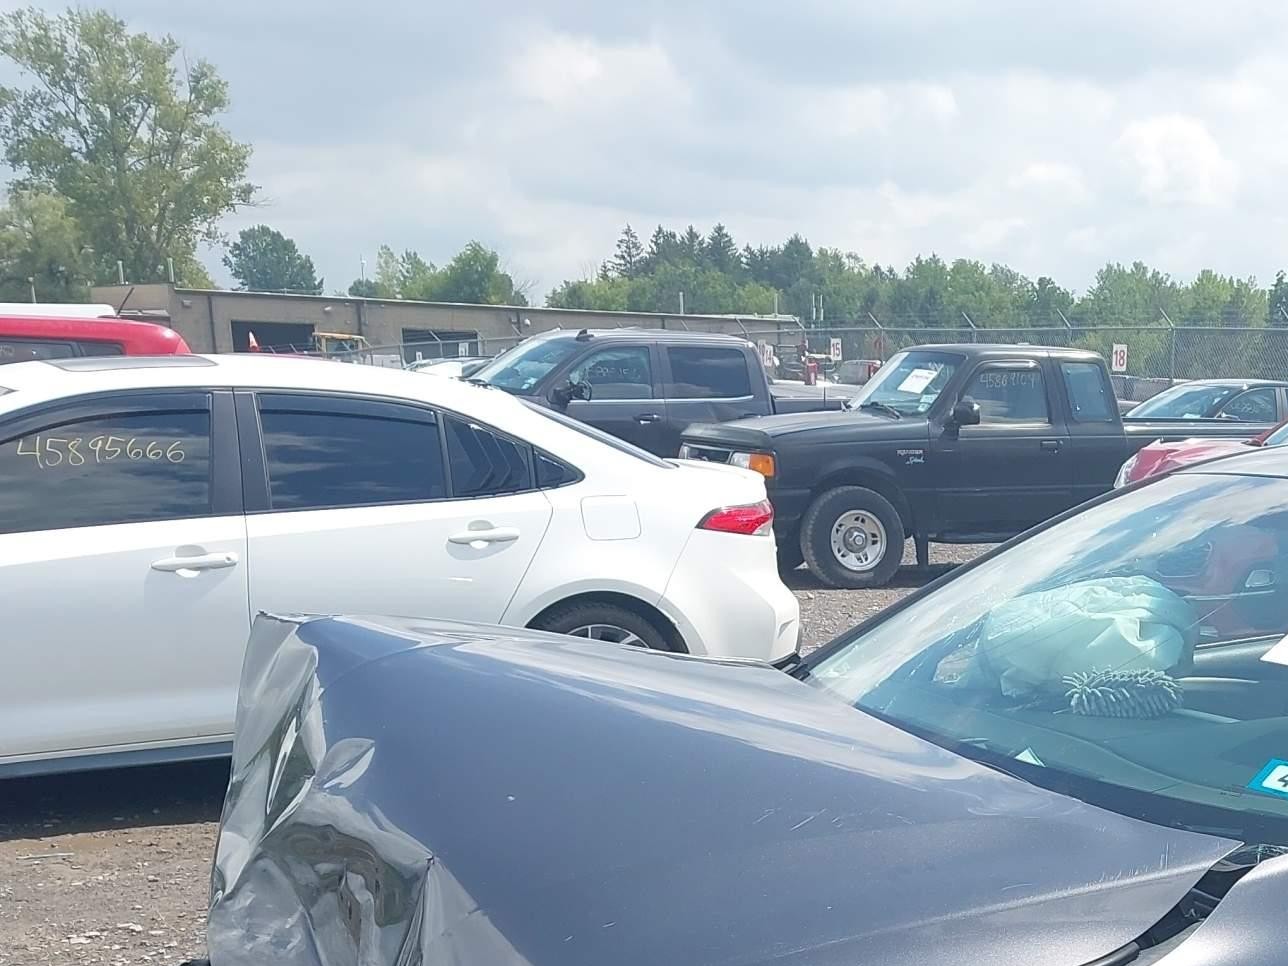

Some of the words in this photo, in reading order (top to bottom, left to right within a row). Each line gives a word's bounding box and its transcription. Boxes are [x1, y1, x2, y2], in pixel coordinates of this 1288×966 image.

[832, 343, 841, 357] 15
[1114, 350, 1125, 367] 18
[16, 435, 186, 469] 45895666
